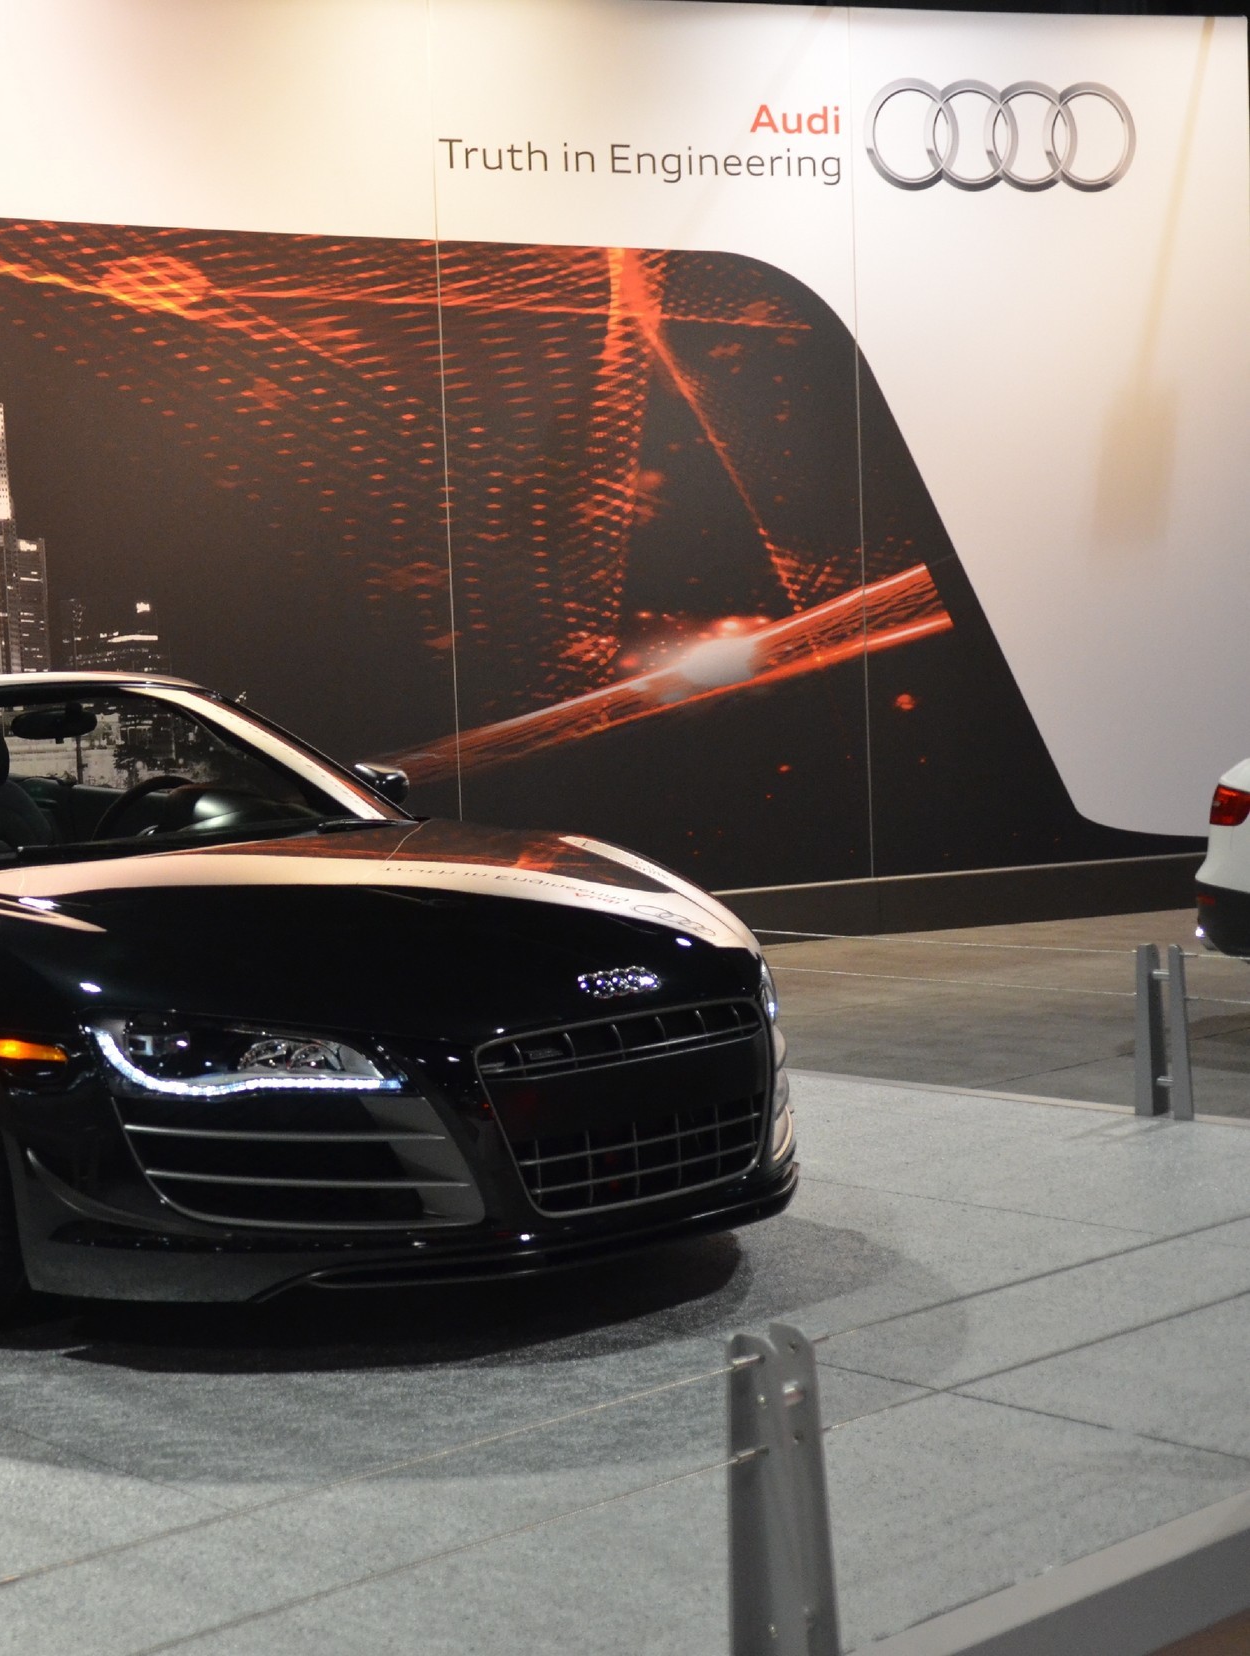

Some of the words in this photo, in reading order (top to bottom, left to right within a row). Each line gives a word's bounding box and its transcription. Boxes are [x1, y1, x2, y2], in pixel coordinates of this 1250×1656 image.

[750, 104, 840, 134] Audi
[438, 138, 548, 172] Truth
[563, 142, 595, 173] in
[610, 144, 841, 186] Engineering
